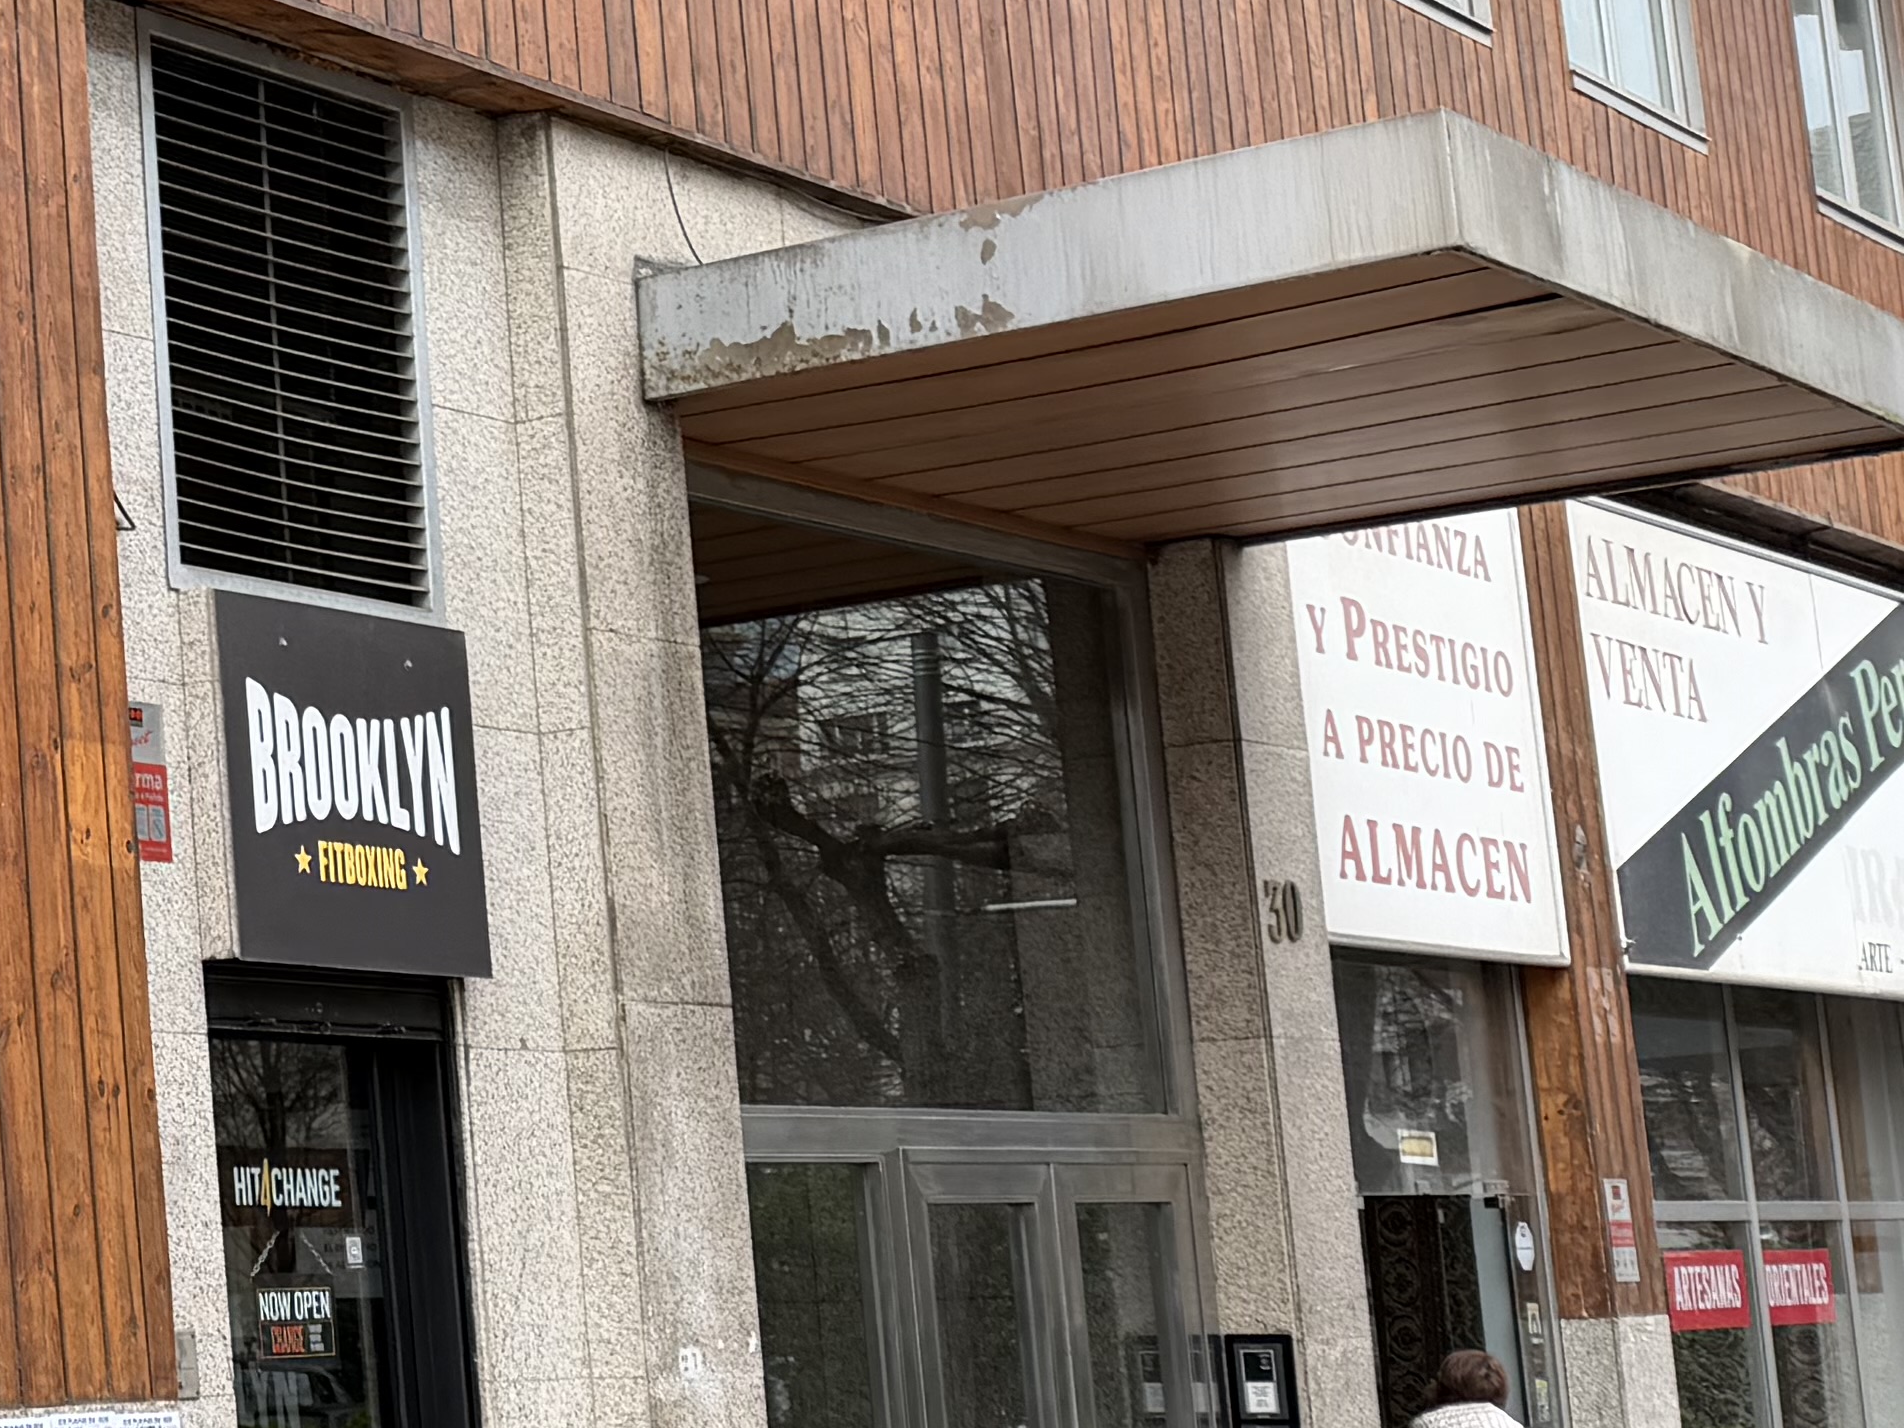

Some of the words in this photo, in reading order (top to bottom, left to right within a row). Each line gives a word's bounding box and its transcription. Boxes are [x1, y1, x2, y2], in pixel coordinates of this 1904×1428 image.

[1305, 603, 1326, 655] Y
[1585, 535, 1742, 639] ALMACEN
[1745, 580, 1769, 645] Y
[1591, 633, 1709, 723] VENTA
[245, 676, 461, 856] BROOKLYN
[1322, 708, 1344, 760] A
[1356, 714, 1473, 784] PRECIO
[1484, 740, 1526, 793] DE
[318, 840, 407, 890] FITBOXING
[1338, 814, 1533, 904] ALMACEN
[1681, 710, 1862, 958] Alfombras
[1262, 880, 1304, 945] 30
[258, 1291, 291, 1321] NOW
[294, 1290, 332, 1320] OPEN
